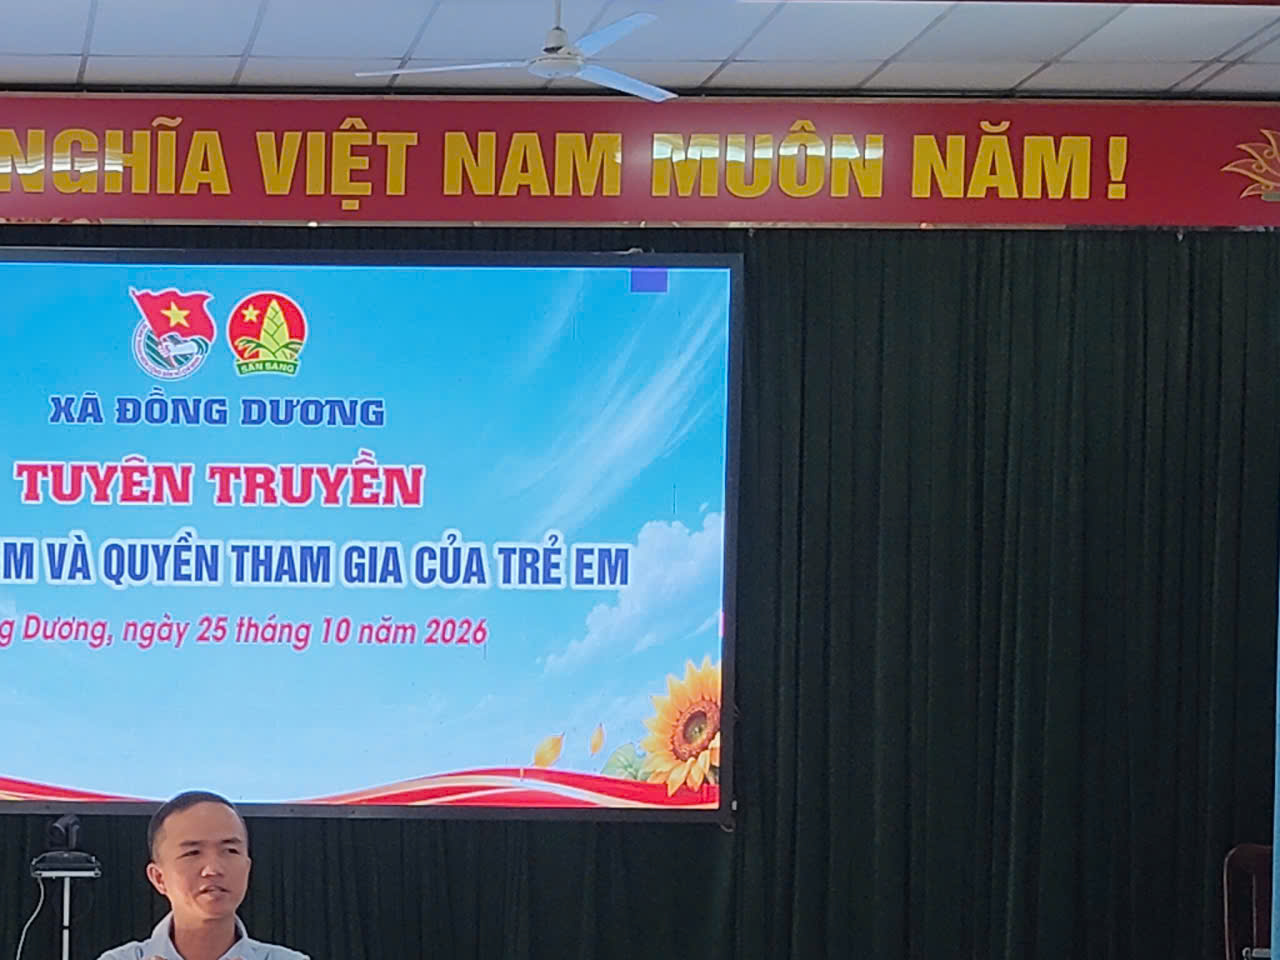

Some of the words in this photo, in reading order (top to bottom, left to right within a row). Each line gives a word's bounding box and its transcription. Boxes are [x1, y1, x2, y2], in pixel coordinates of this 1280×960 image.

[255, 117, 419, 210] VIỆT
[443, 131, 622, 197] NAM
[651, 119, 884, 198] MUÔN
[49, 391, 104, 424] XÃ
[115, 386, 228, 425] ĐỒNG
[240, 398, 385, 427] DƯƠNG
[15, 456, 193, 504] TUYÊN
[208, 450, 425, 506] TRUYỀN
[46, 534, 92, 581] VÀ
[103, 530, 219, 586] QUYỀN
[231, 545, 331, 583] THAM
[343, 545, 403, 584] GIA
[414, 533, 487, 585] CỦA
[497, 533, 562, 585] TRẺ
[575, 547, 629, 586] EM
[23, 614, 113, 648] Dương,
[123, 613, 191, 649] ngày
[196, 616, 228, 643] 25
[236, 614, 312, 650] tháng
[322, 616, 352, 644] 10
[357, 616, 416, 644] năm
[424, 618, 488, 645] 2026
